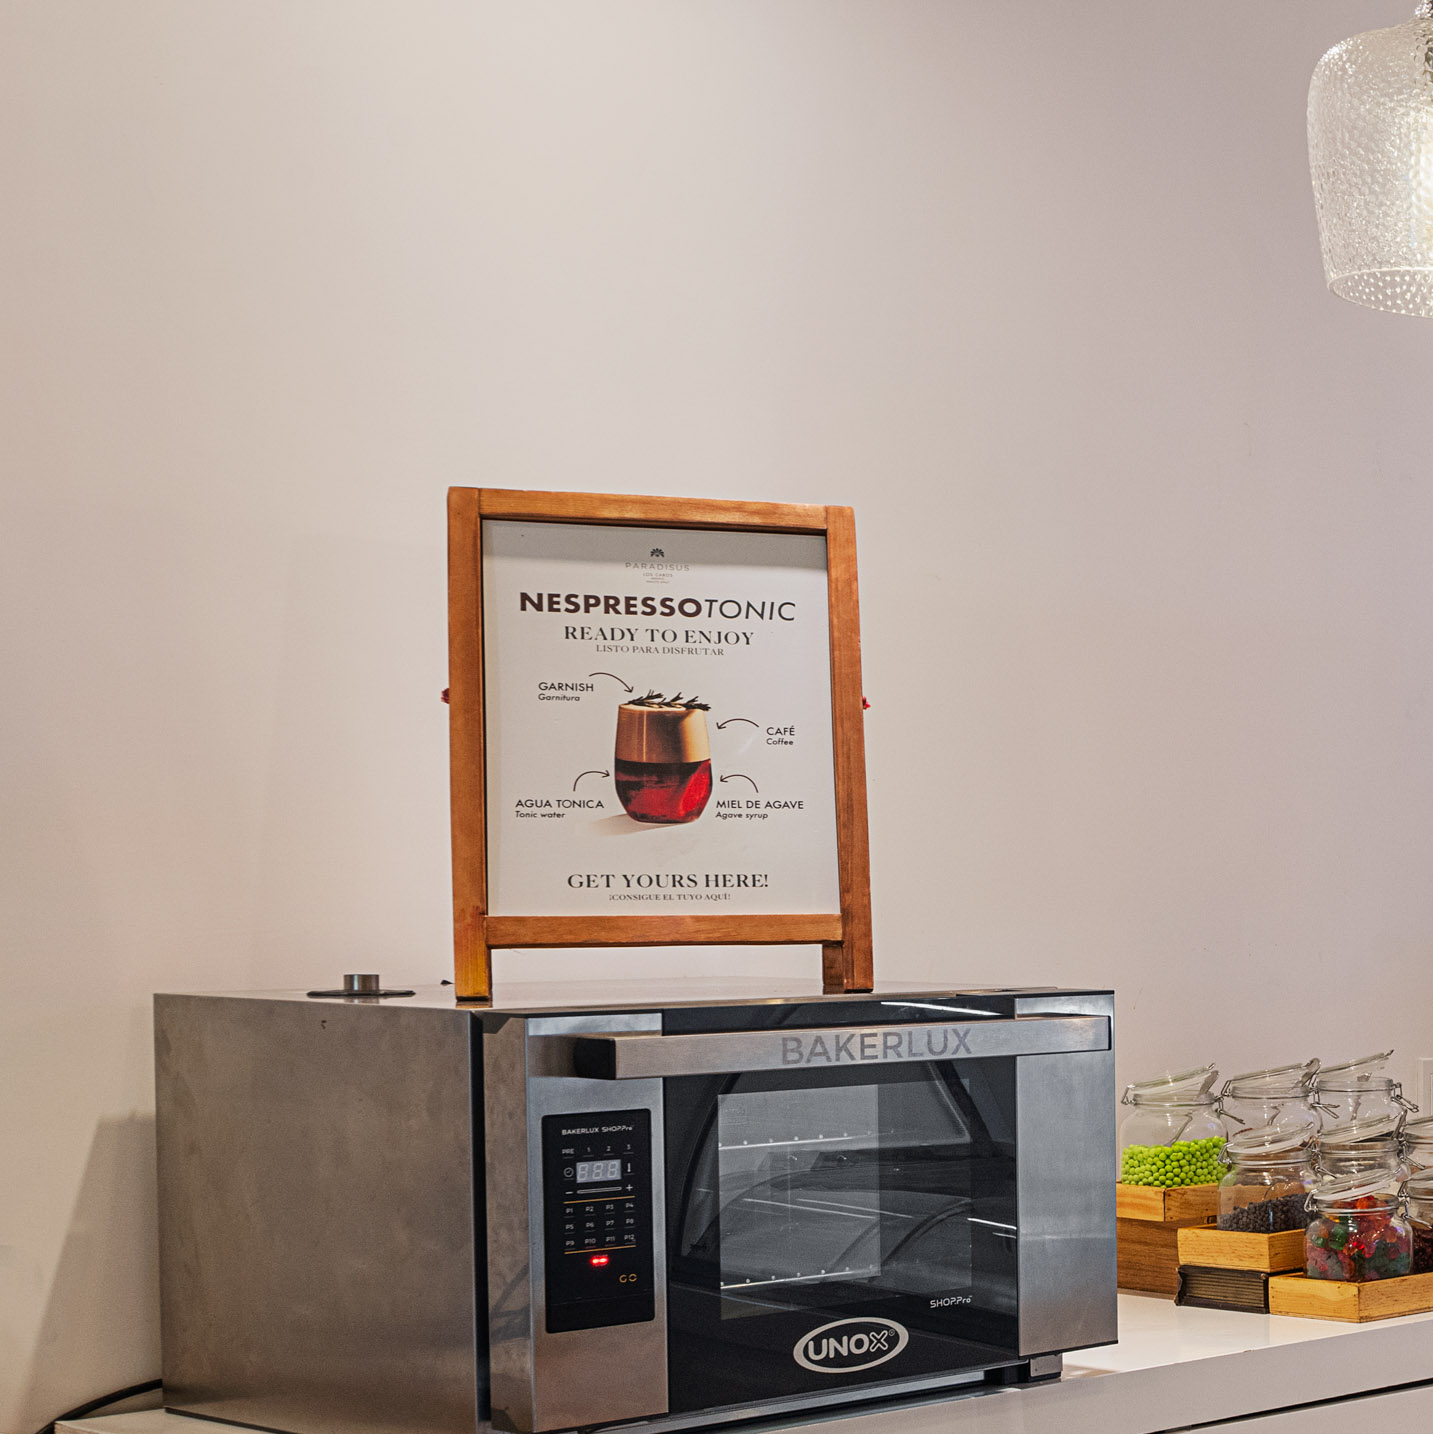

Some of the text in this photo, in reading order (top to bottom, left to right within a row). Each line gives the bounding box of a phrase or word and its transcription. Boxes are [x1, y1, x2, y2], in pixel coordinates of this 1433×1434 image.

[625, 562, 690, 571] PARADISUS
[519, 591, 796, 621] NESPRESSOTONIC
[564, 626, 755, 646] READY TO ENJOY
[596, 644, 724, 656] LISTO PARA DISFRUTAR
[538, 682, 594, 692] GARNISH
[537, 693, 580, 701] Garnitura
[766, 725, 795, 736] CAFÉ
[766, 737, 794, 745] Coffee
[515, 799, 605, 809] AGUA TONICA
[716, 800, 804, 809] MIEL DE AGAVE
[540, 811, 566, 819] water
[715, 811, 768, 820] Agave syrup
[567, 873, 769, 888] GET YOURS HERE!
[609, 893, 661, 901] ¡CONSIGUE
[781, 1028, 972, 1065] BAKERLUX
[561, 1127, 599, 1136] BAKERLUX
[808, 1329, 889, 1361] UNOX
